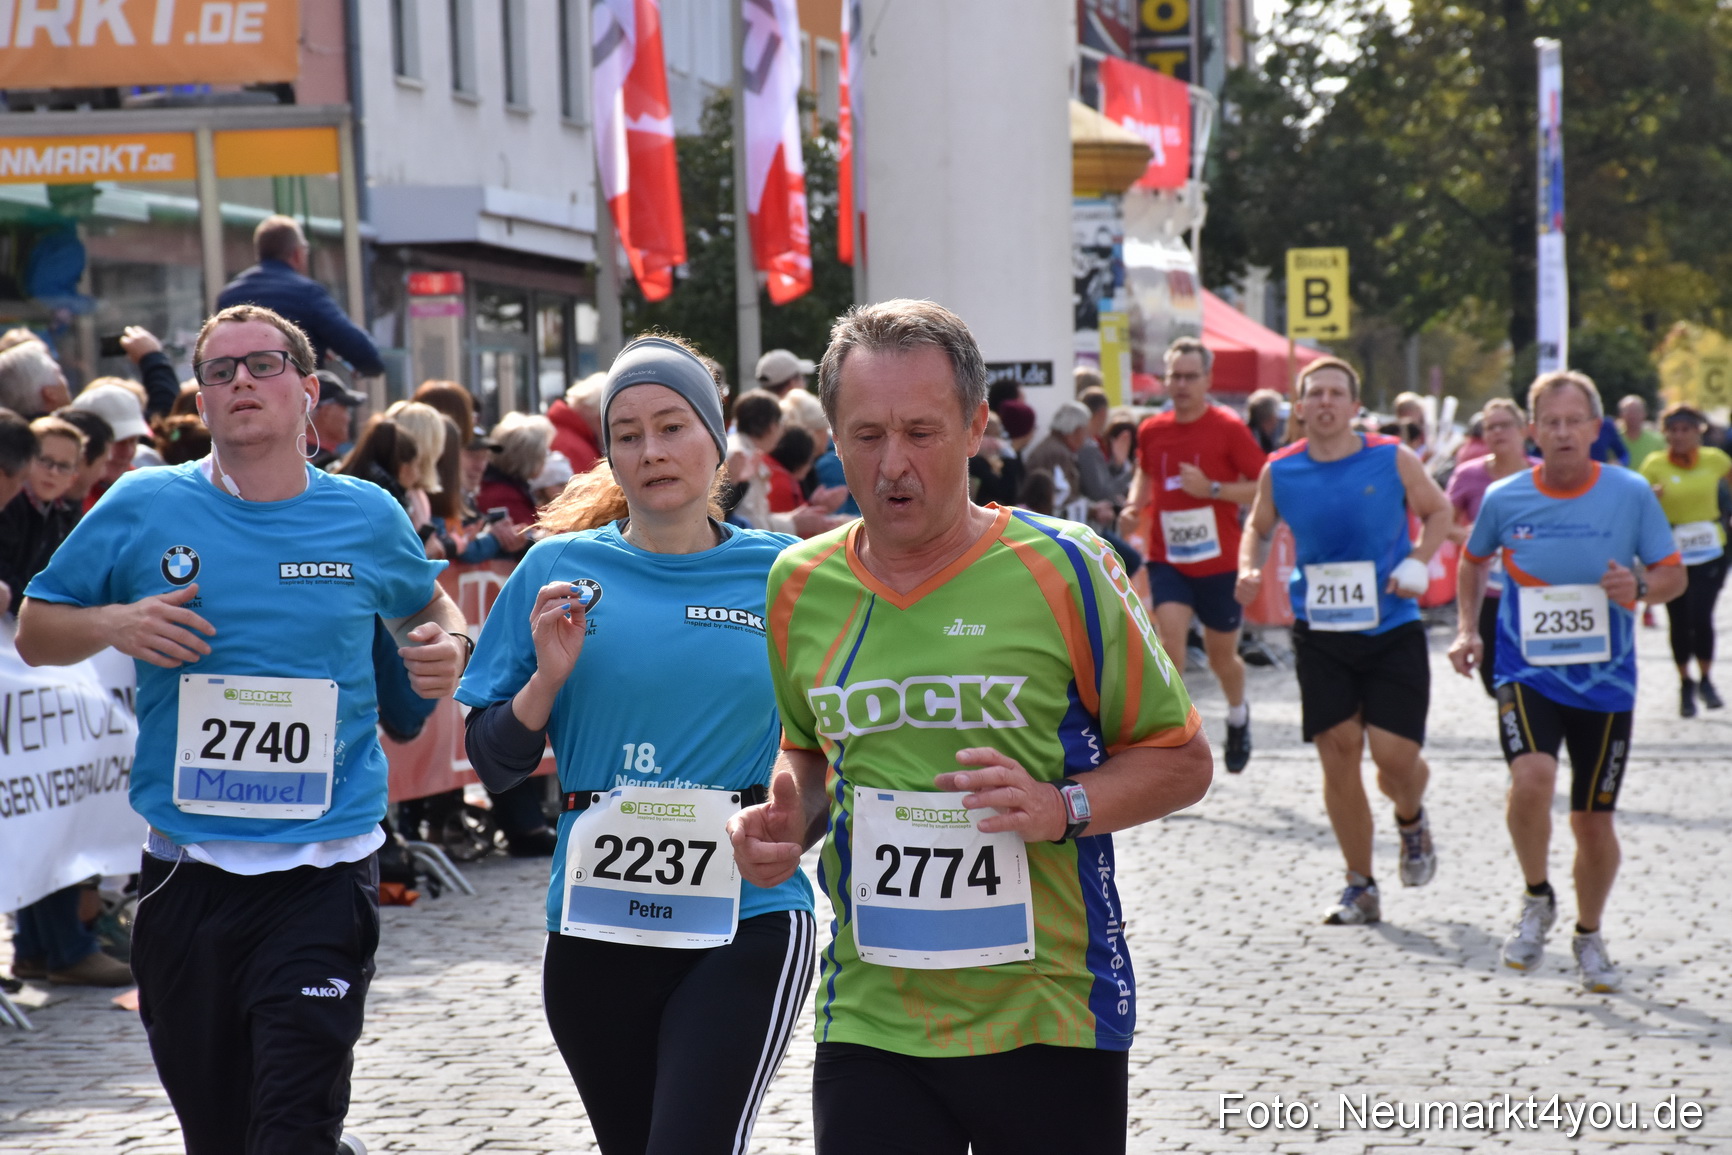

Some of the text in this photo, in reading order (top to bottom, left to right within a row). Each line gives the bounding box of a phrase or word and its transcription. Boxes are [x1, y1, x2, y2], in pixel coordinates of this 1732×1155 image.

[0, 0, 268, 48] RKT.DE
[1303, 276, 1333, 319] B
[279, 562, 354, 579] BOCK
[1316, 583, 1364, 604] 2114
[684, 619, 712, 628] inspired
[724, 624, 744, 632] smart
[744, 627, 767, 638] concep
[686, 605, 766, 632] BOCK
[1534, 608, 1595, 634] 2335
[239, 689, 292, 703] BOCK
[808, 674, 1029, 741] BOCK
[200, 718, 310, 763] 2740
[622, 742, 662, 774] 18.
[195, 768, 306, 803] Manuel
[638, 802, 695, 818] BOCK
[911, 807, 970, 824] BOCK
[593, 834, 717, 886] 2237
[875, 844, 1001, 899] 2774
[861, 887, 867, 897] D
[629, 900, 673, 919] Petra
[301, 987, 339, 997] JAKO
